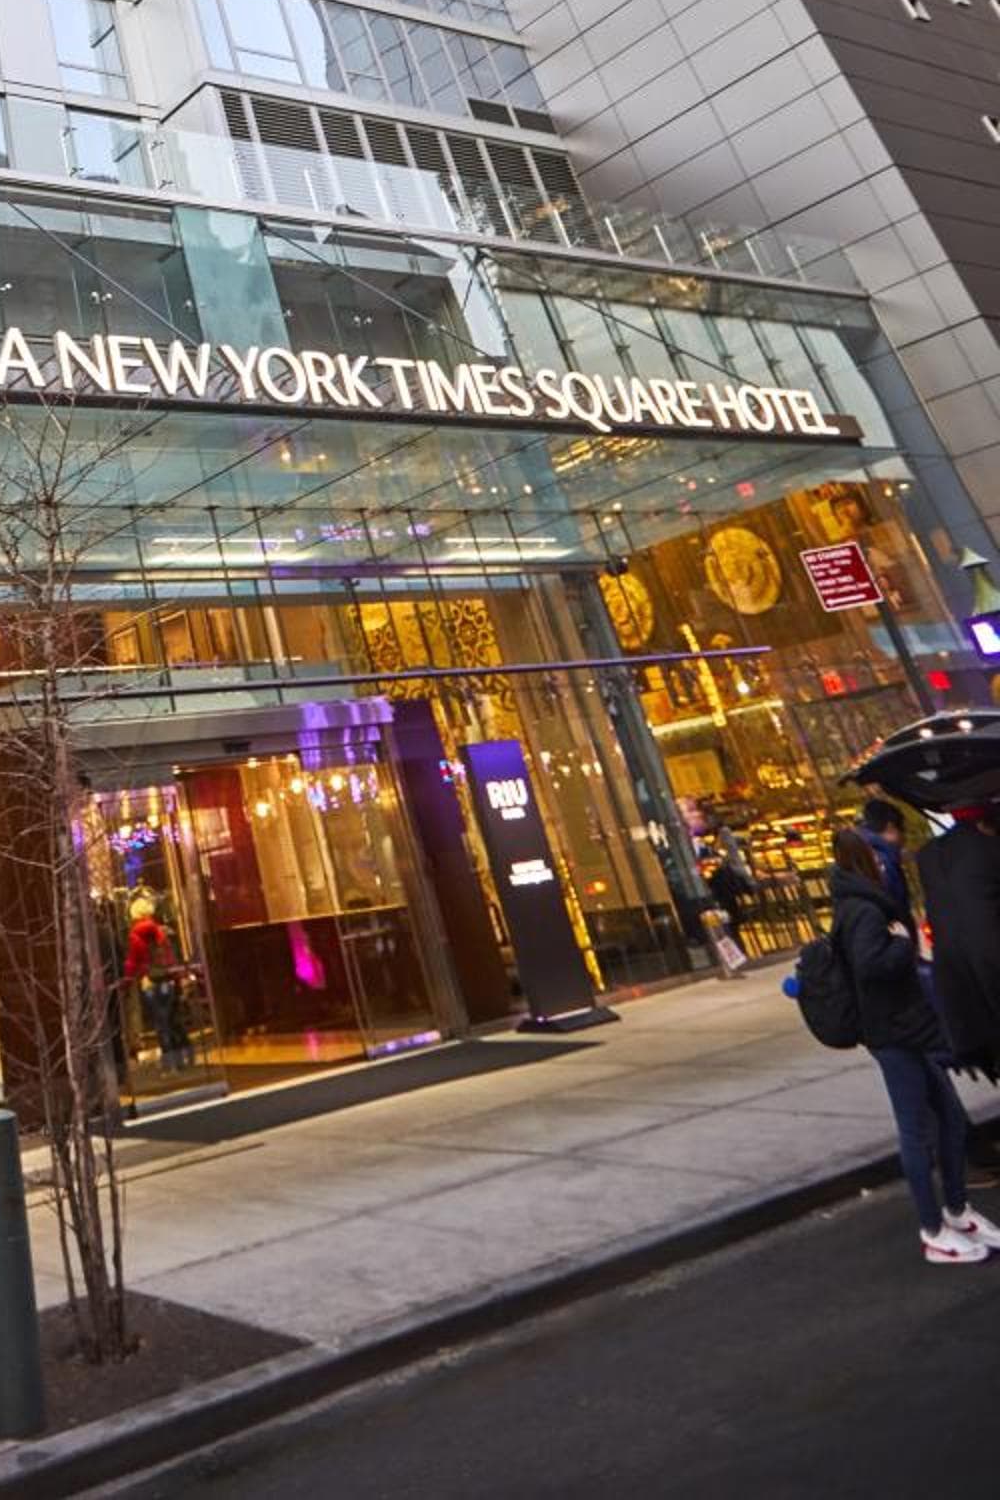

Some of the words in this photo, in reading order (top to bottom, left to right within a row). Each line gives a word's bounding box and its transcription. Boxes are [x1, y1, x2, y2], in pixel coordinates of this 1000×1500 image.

[54, 330, 211, 398] NEW
[219, 345, 383, 412] YORK
[376, 356, 535, 418] TIMES
[534, 366, 713, 431] SQUARE
[708, 381, 839, 435] HOTEL
[486, 778, 528, 809] RIU
